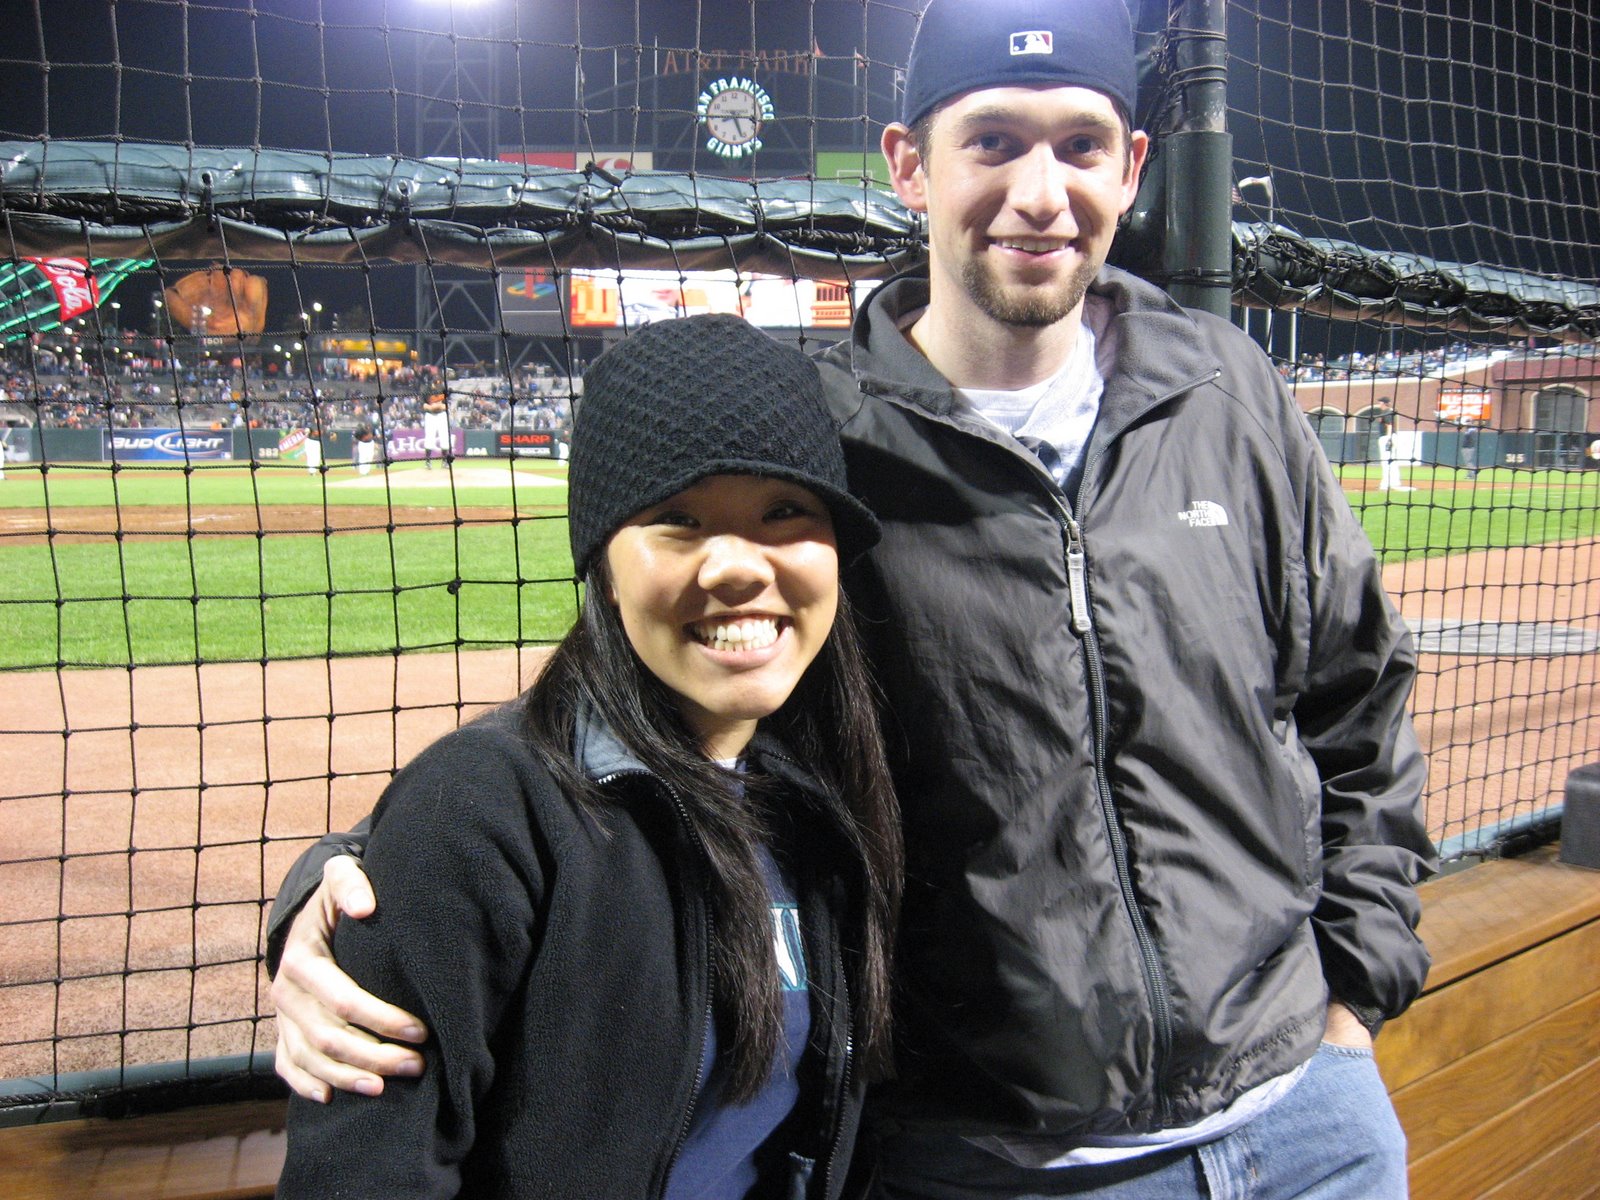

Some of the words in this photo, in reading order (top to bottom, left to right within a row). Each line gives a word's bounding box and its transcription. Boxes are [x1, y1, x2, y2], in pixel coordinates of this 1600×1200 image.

[663, 49, 726, 76] AT&T
[739, 49, 811, 76] PARK
[709, 76, 775, 120] FRANCISCO
[706, 137, 763, 158] GIANTS
[108, 437, 154, 449] BUD
[164, 437, 224, 449] LIGHT
[499, 433, 551, 445] SHARP
[1192, 500, 1209, 510] THE
[1177, 510, 1210, 520] NORTH
[1189, 518, 1215, 527] FACE
